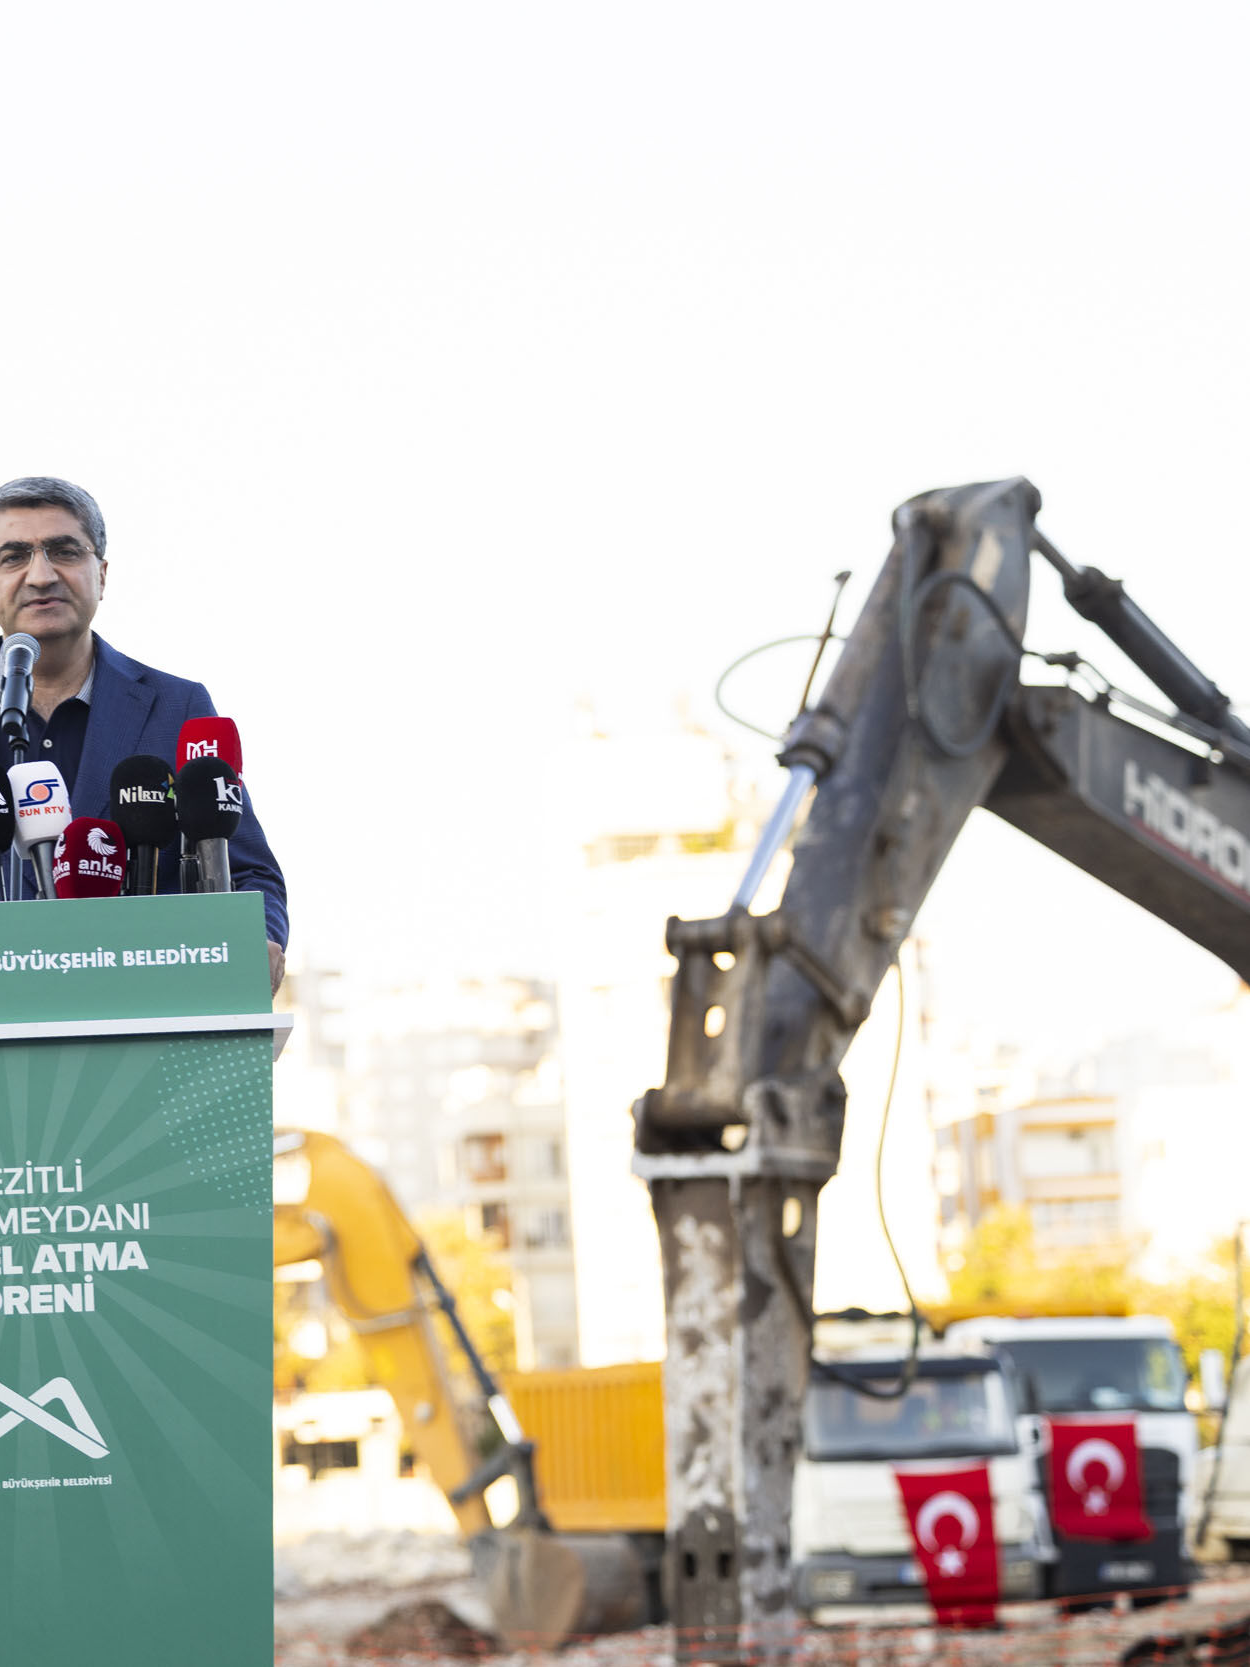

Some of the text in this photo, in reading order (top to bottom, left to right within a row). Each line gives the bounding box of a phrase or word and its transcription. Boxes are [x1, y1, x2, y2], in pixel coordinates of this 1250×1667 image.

[18, 807, 41, 818] SUN
[44, 806, 65, 815] RTV
[78, 856, 123, 876] anka
[123, 942, 229, 967] BELEDİYESİ
[31, 1240, 150, 1274] ATMA
[2, 1477, 61, 1490] BÜYÜKŞEHİR
[62, 1475, 113, 1487] BELEDİYESİ
